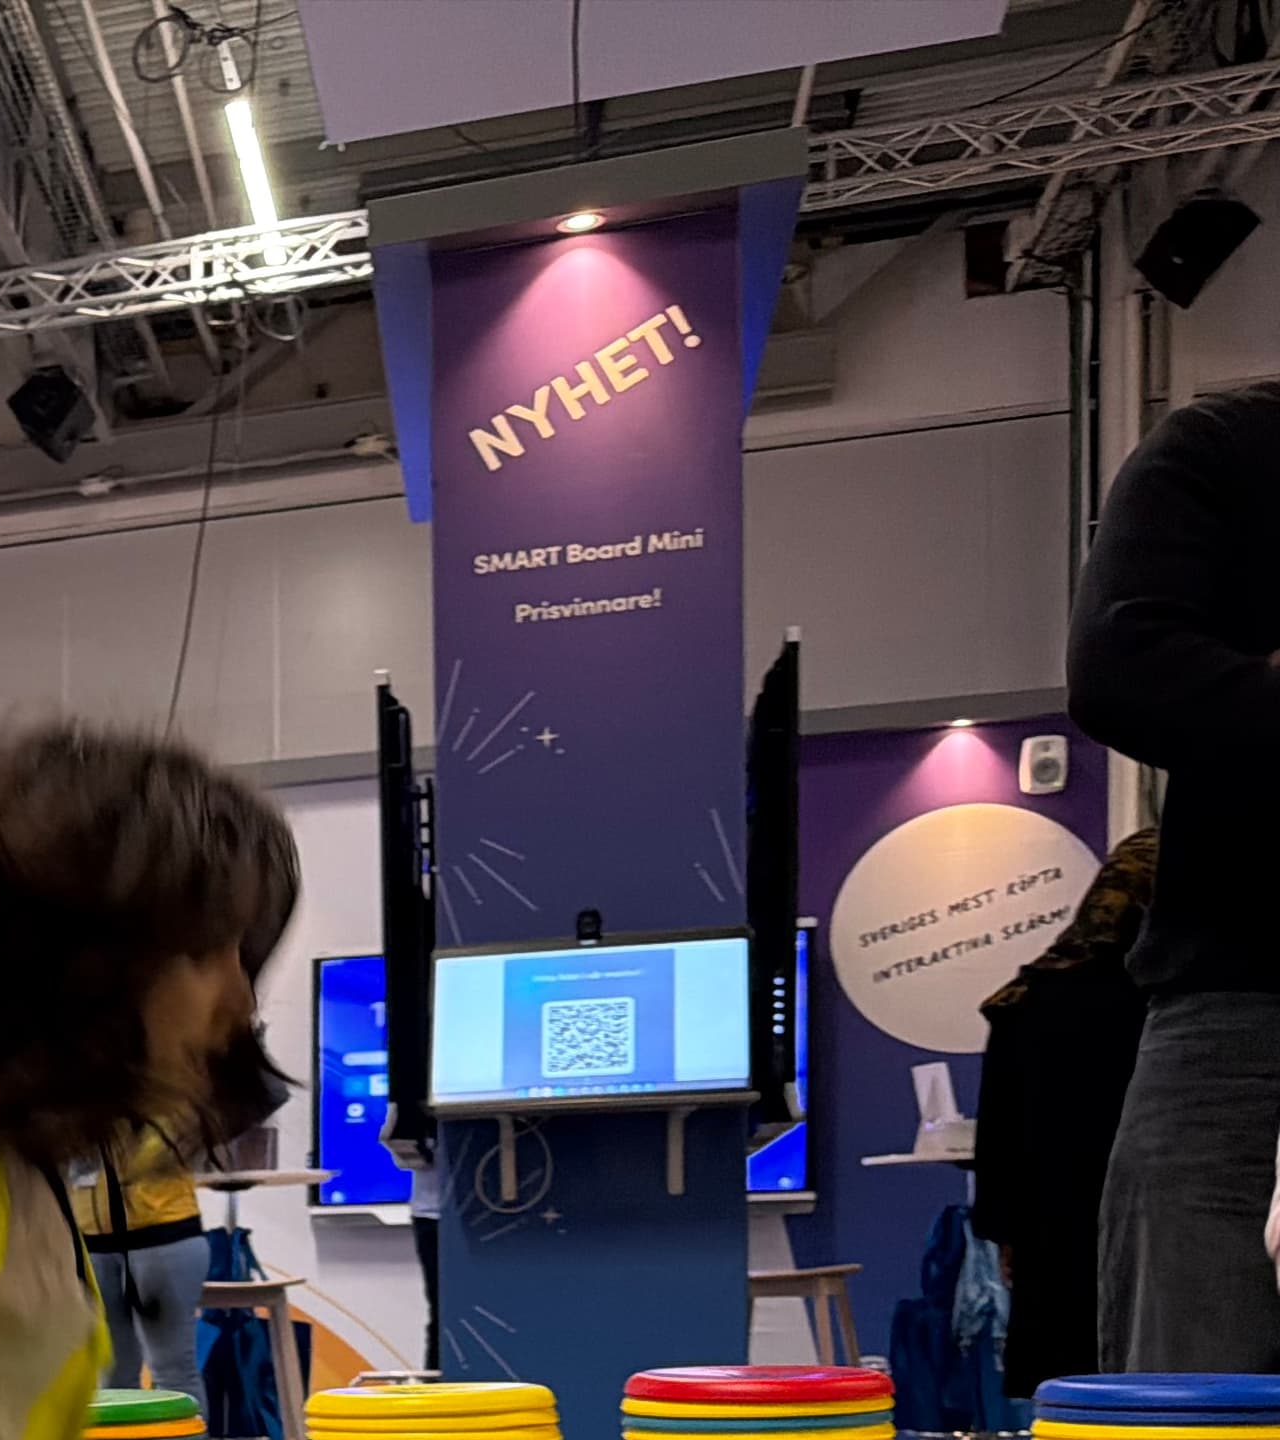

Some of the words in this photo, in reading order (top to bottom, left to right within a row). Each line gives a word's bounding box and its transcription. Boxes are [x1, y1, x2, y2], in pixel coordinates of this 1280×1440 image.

[468, 304, 703, 473] NYHET!
[473, 546, 562, 575] SMART
[566, 535, 642, 565] Board
[647, 527, 704, 554] Mini
[514, 587, 663, 623] Prisvinnare!
[858, 909, 939, 948] SVERIGES
[946, 888, 996, 917] MEST
